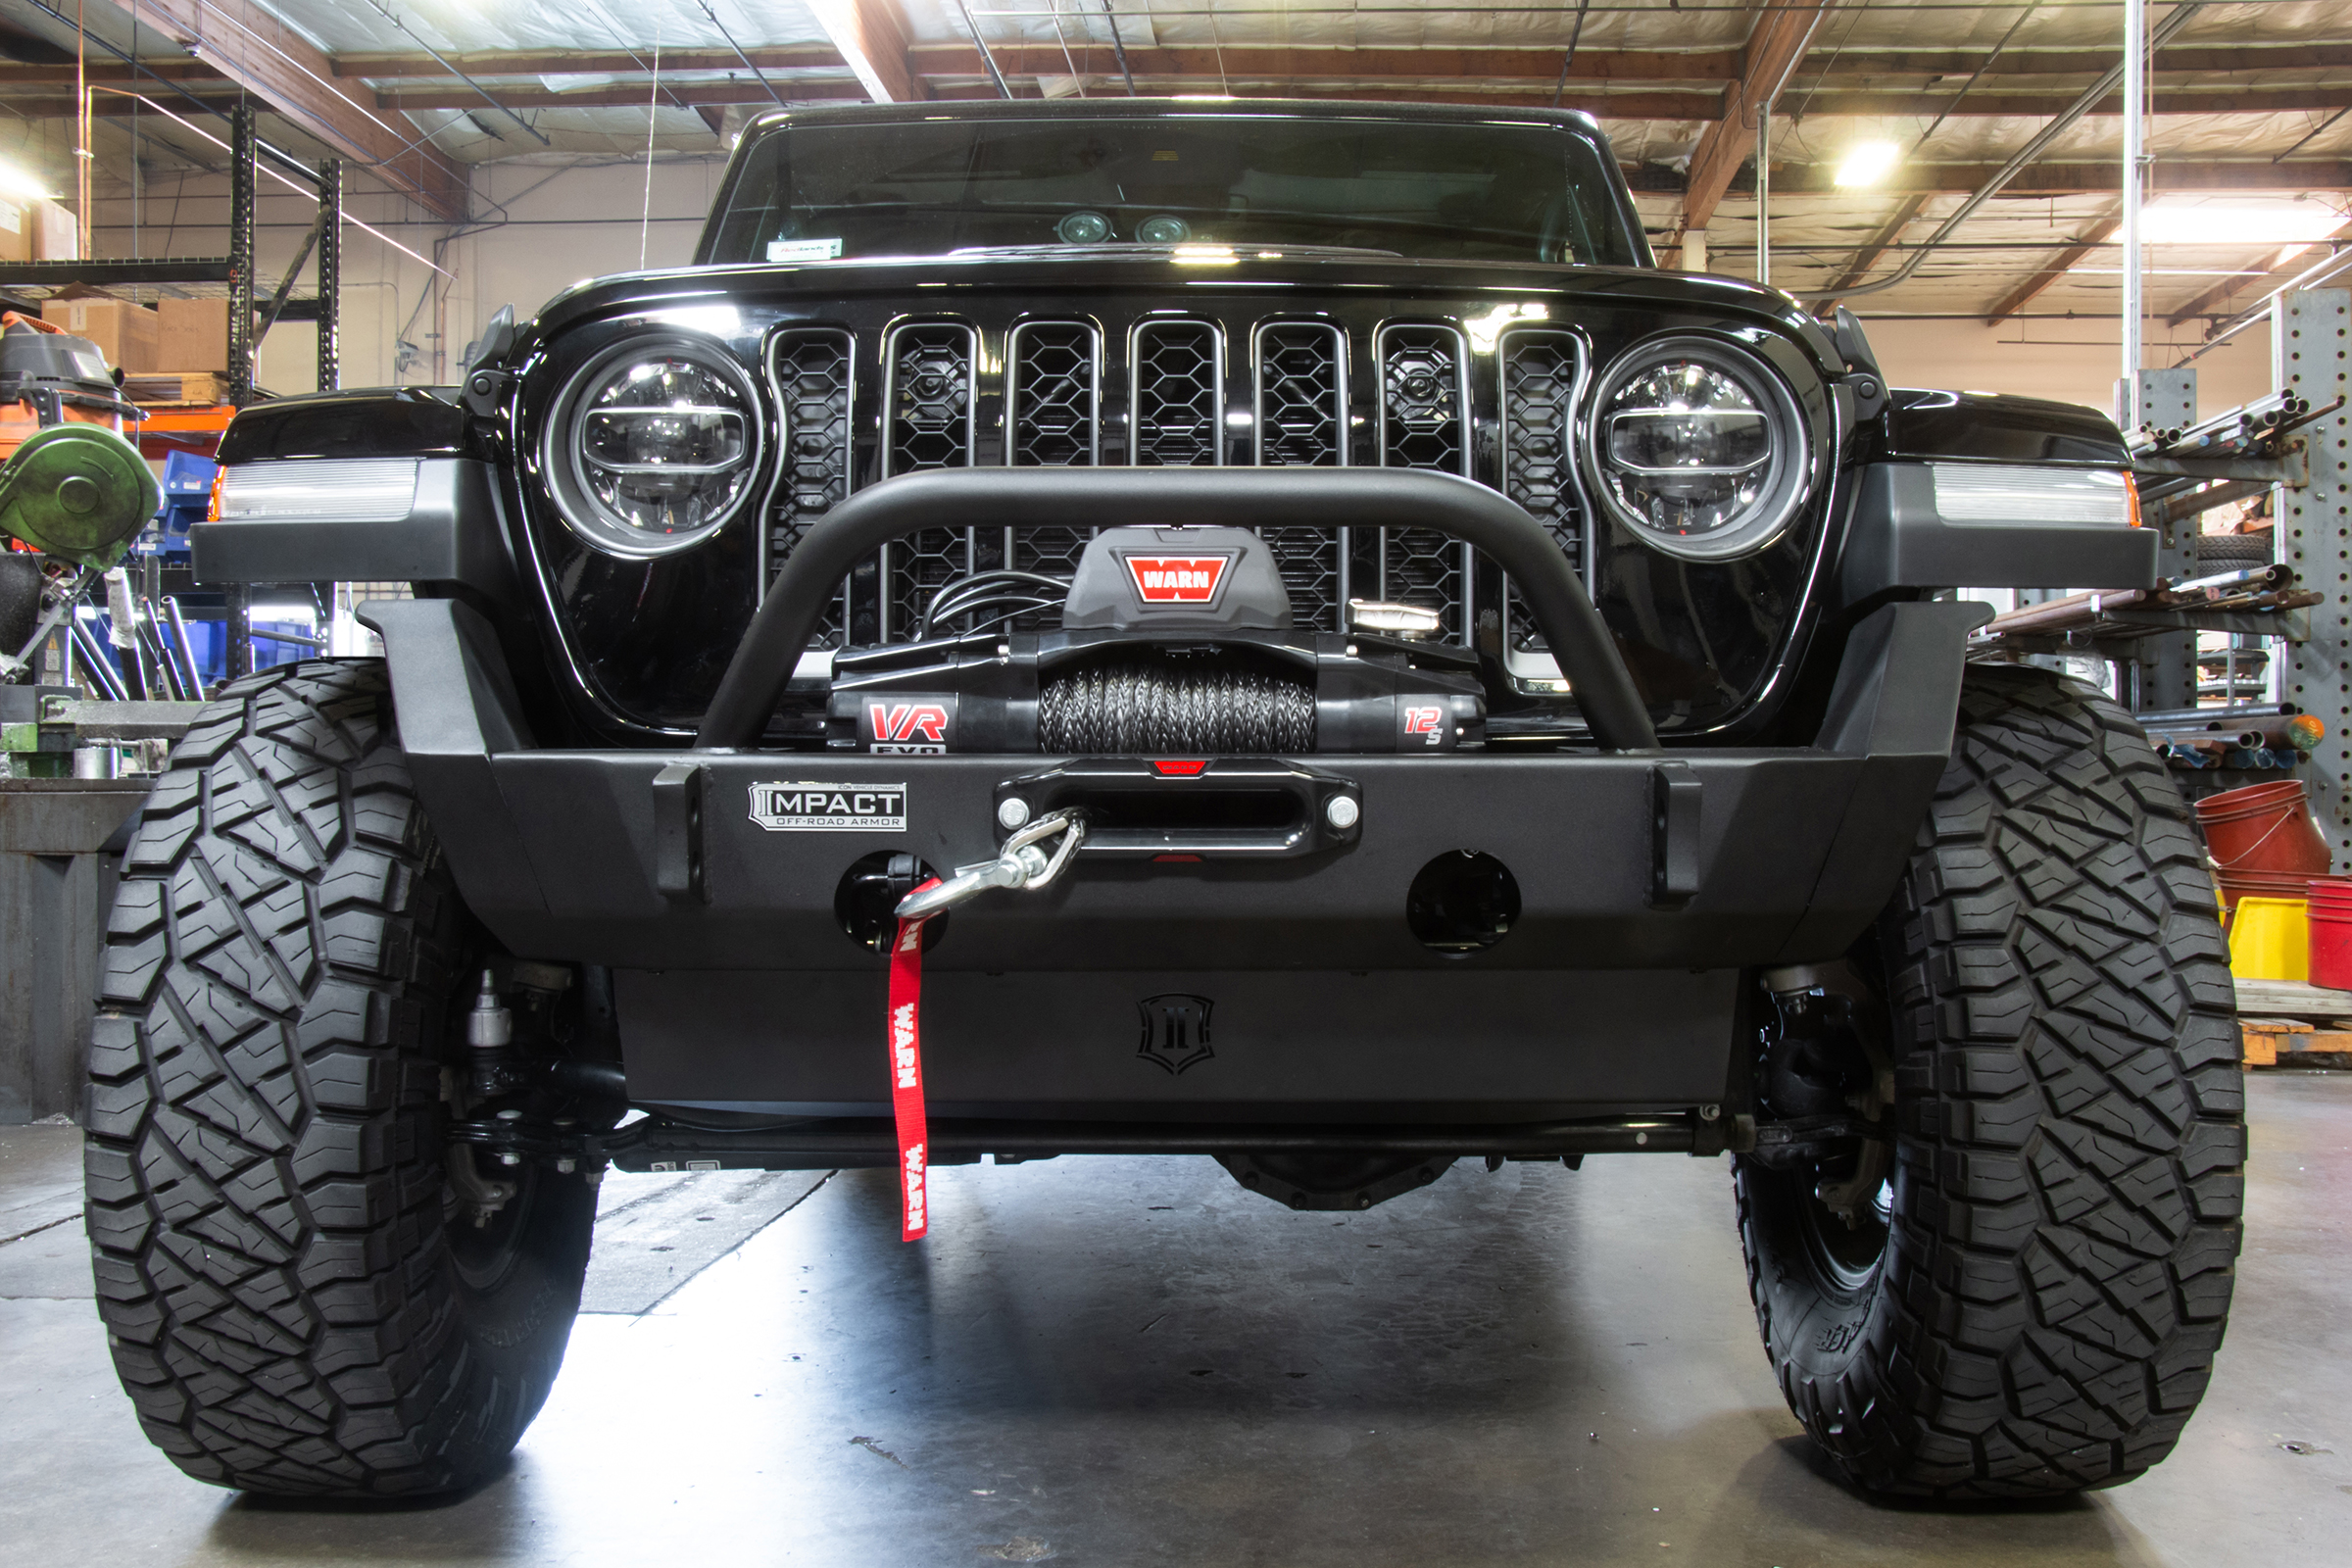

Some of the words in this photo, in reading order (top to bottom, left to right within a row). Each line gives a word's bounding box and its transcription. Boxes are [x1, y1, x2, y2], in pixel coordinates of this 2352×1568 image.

[1143, 571, 1209, 588] WARN
[869, 705, 949, 742] VR
[776, 817, 845, 826] OFF-ROAD
[850, 817, 901, 826] ARMOR
[894, 1003, 917, 1089] WARN
[905, 1143, 924, 1231] WARN
